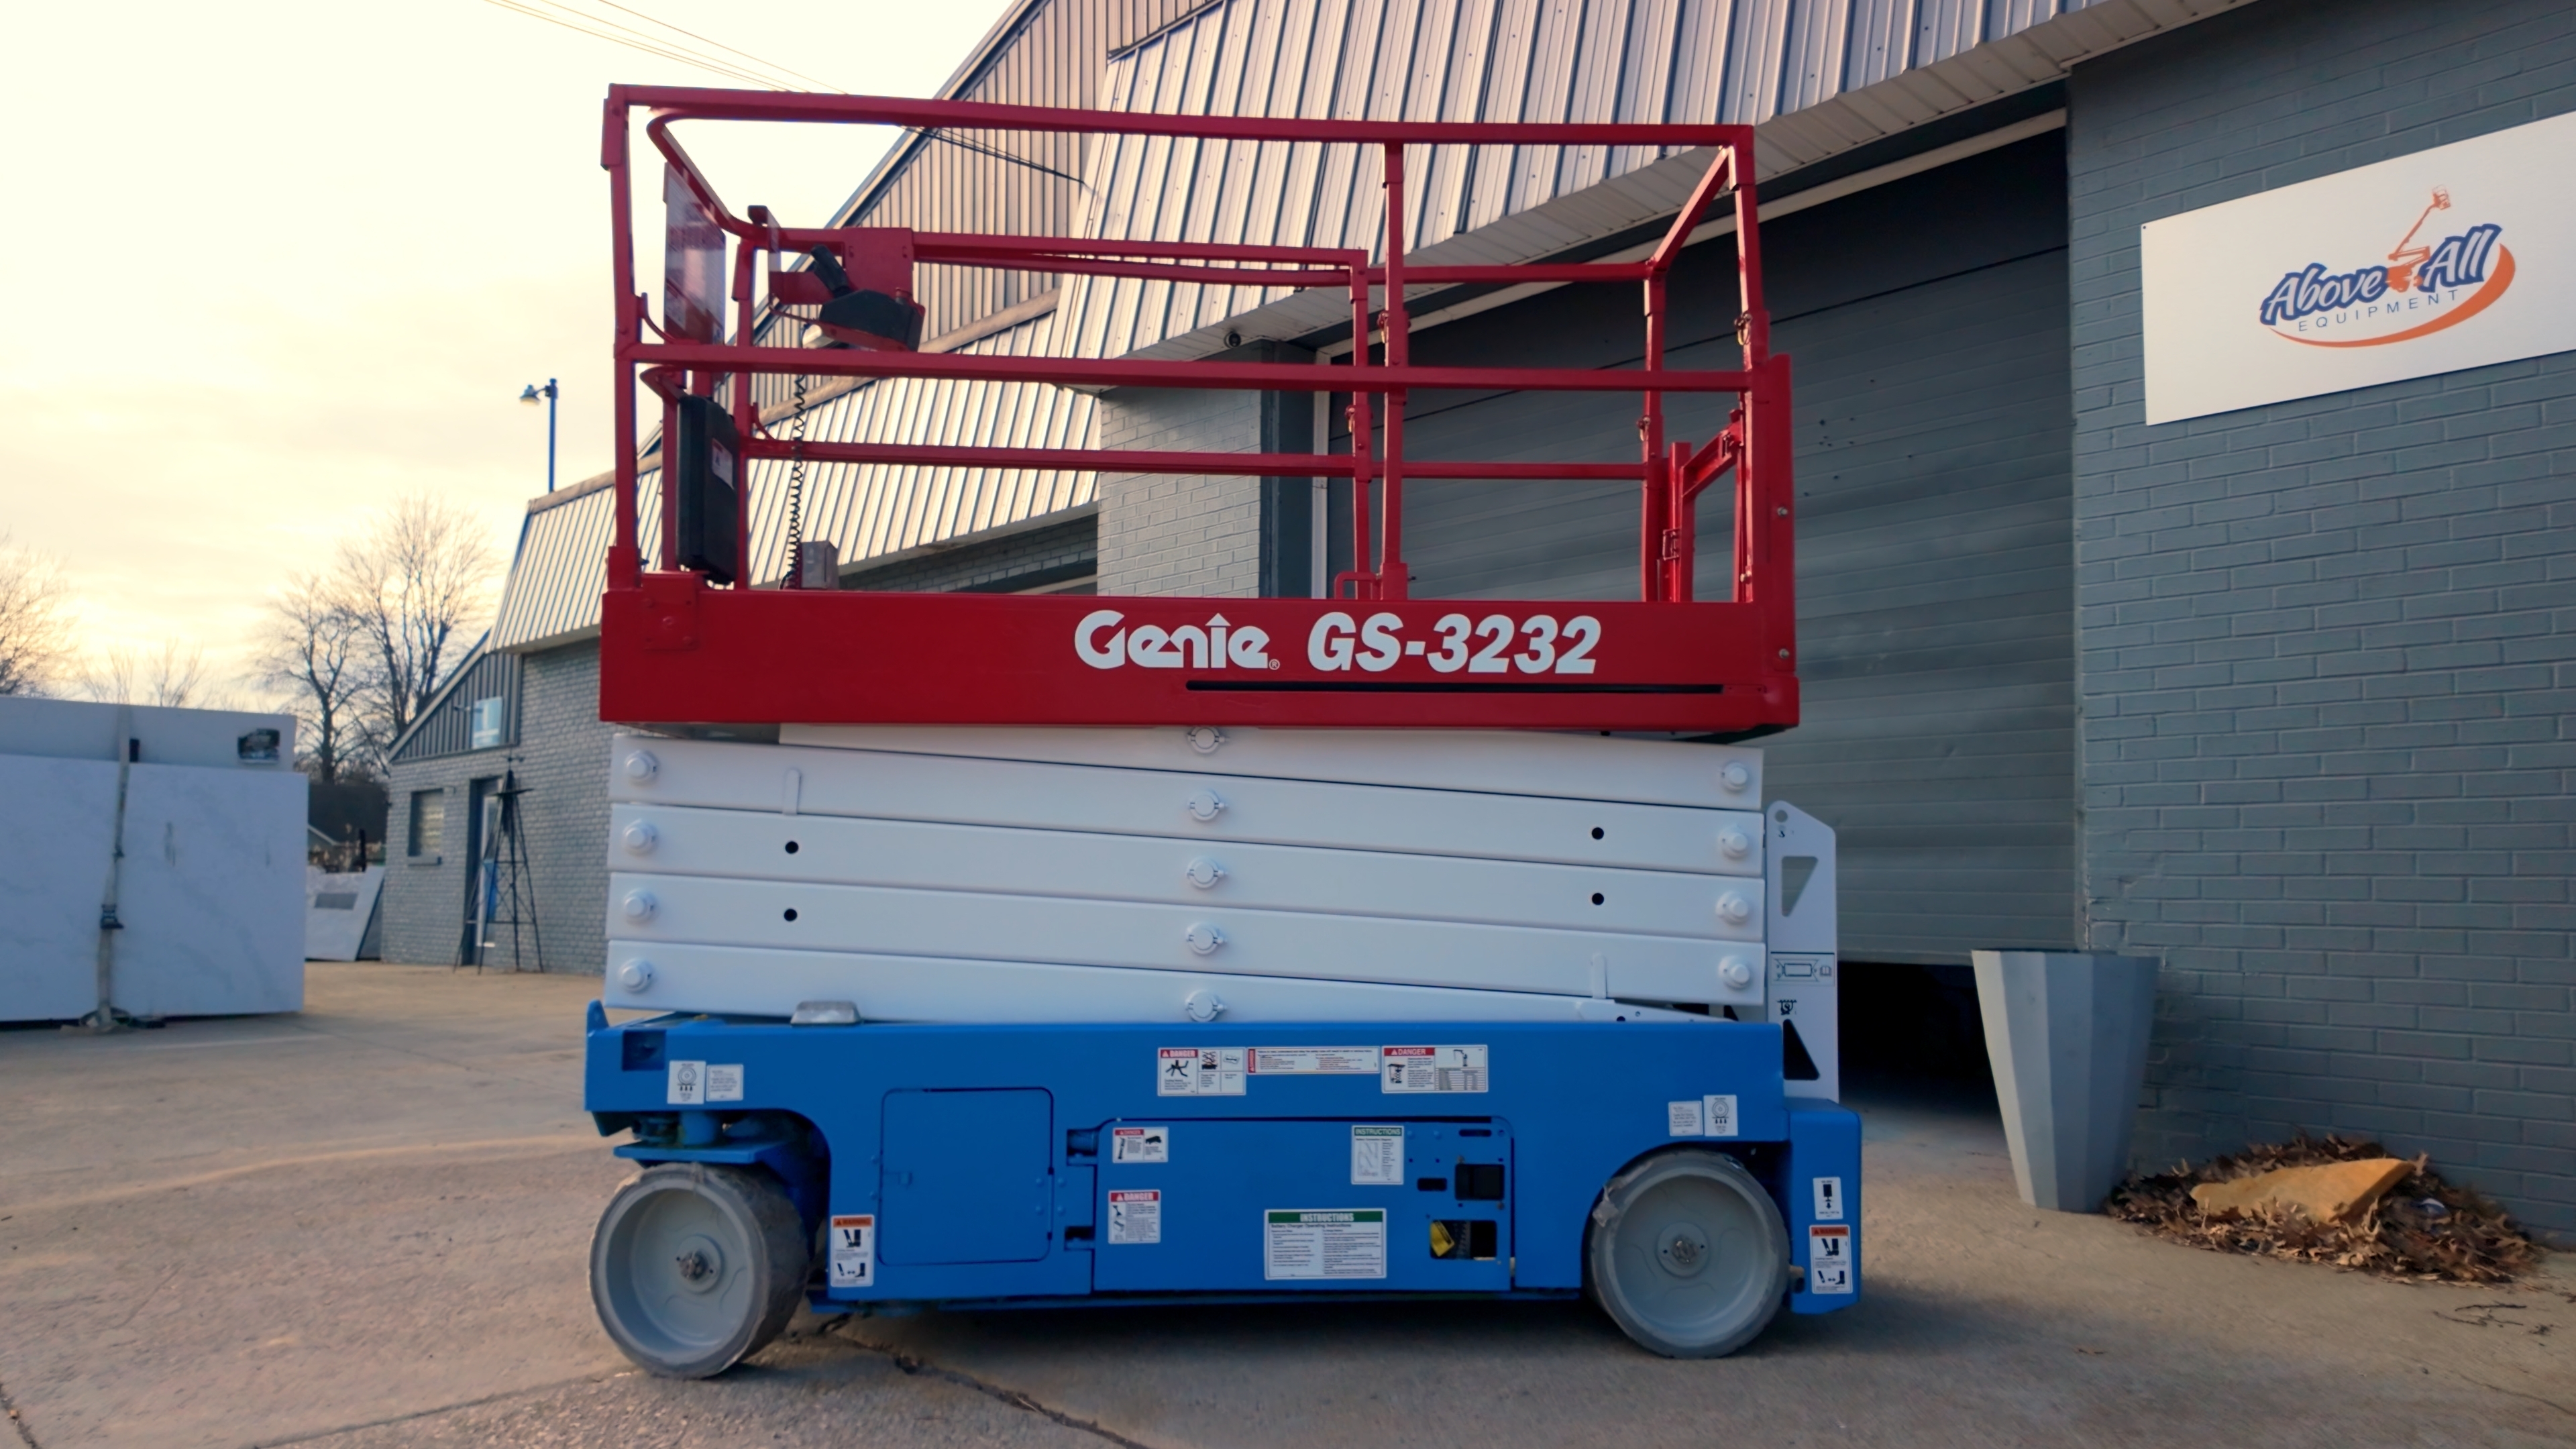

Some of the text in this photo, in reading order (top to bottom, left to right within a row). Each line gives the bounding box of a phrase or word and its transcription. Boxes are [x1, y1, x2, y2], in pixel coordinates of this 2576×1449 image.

[2260, 223, 2503, 325] Above All
[2298, 288, 2459, 332] EQUIPMENT
[1075, 609, 1601, 675] Genie GS-3232
[1124, 1192, 1154, 1201] DANGER
[1299, 1213, 1354, 1222] INSTRUCTIONS
